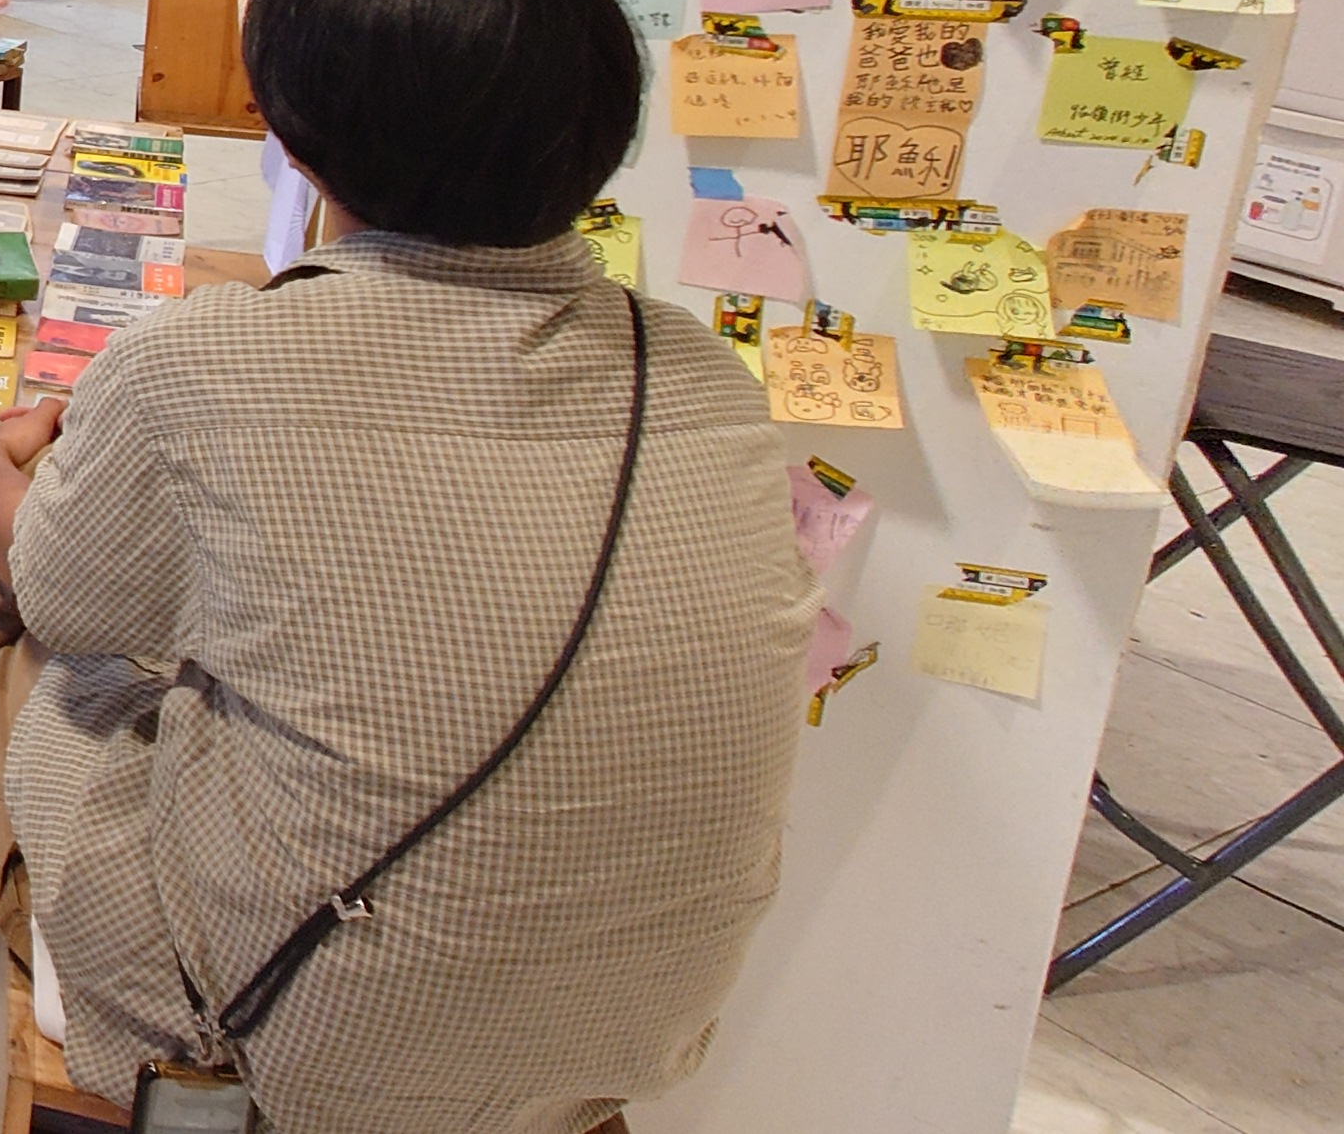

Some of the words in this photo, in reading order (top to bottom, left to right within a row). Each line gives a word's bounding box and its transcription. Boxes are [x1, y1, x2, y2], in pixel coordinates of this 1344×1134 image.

[861, 17, 971, 46] 我愛我的
[857, 44, 941, 71] 爸爸也
[835, 132, 958, 188] 耶穌!
